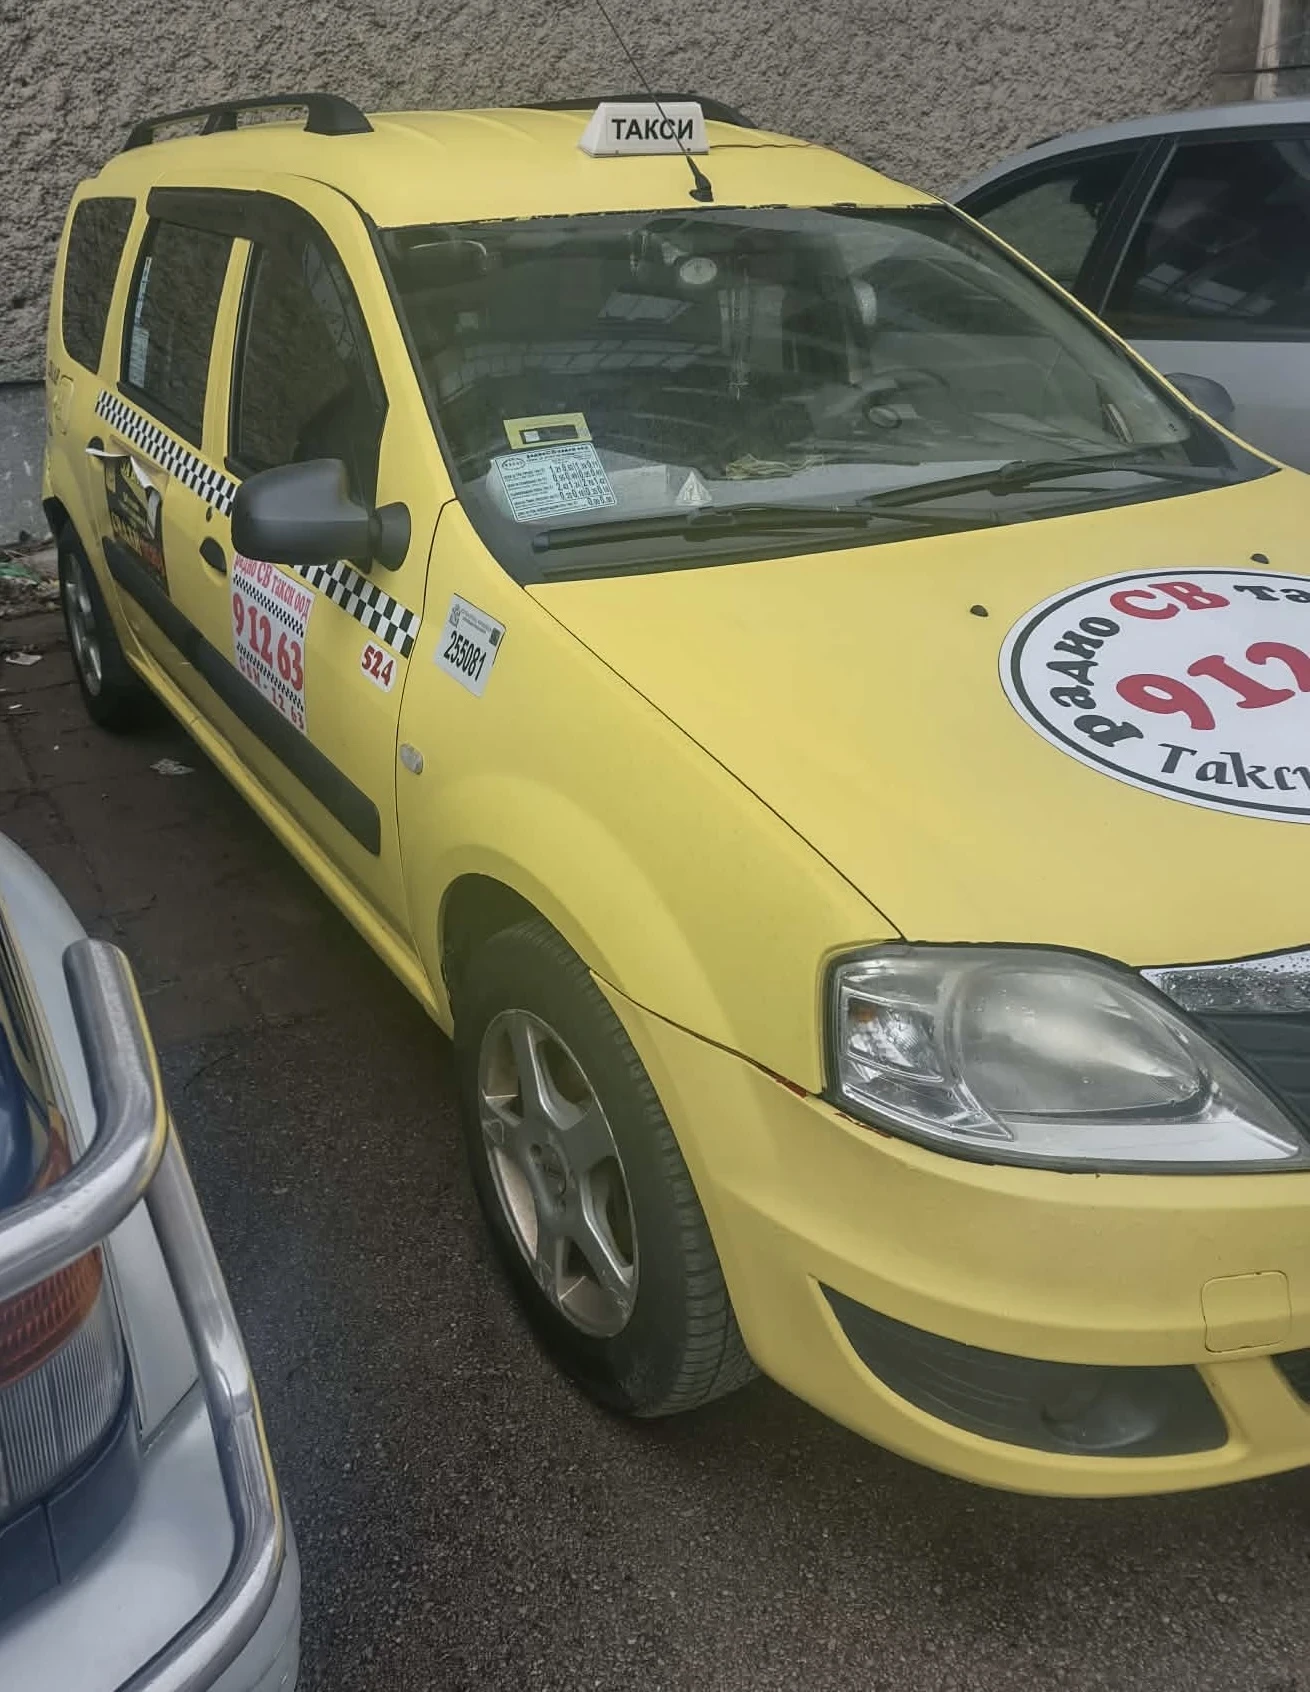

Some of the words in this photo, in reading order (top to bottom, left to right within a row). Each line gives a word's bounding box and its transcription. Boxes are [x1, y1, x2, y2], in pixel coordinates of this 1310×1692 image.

[611, 118, 693, 140] ТАКСИ
[1109, 581, 1231, 620] СВ
[361, 645, 394, 687] 524
[443, 630, 487, 682] 255081
